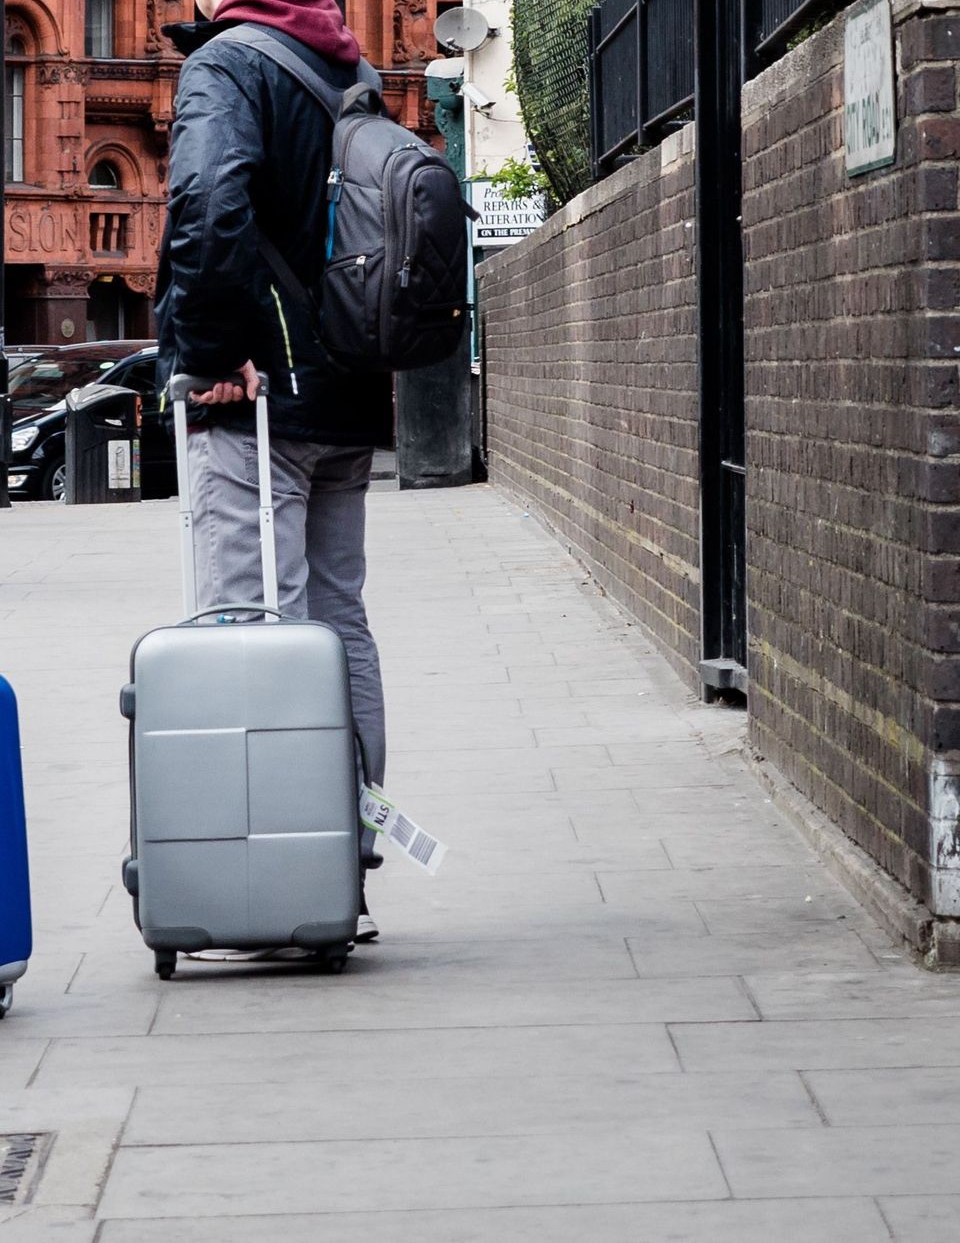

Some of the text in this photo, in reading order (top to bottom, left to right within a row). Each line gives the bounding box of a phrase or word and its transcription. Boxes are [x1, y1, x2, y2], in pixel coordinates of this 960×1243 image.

[484, 201, 528, 211] REPAIRS
[478, 214, 545, 225] ALTERATION
[9, 211, 83, 253] SION
[374, 804, 390, 826] STN
